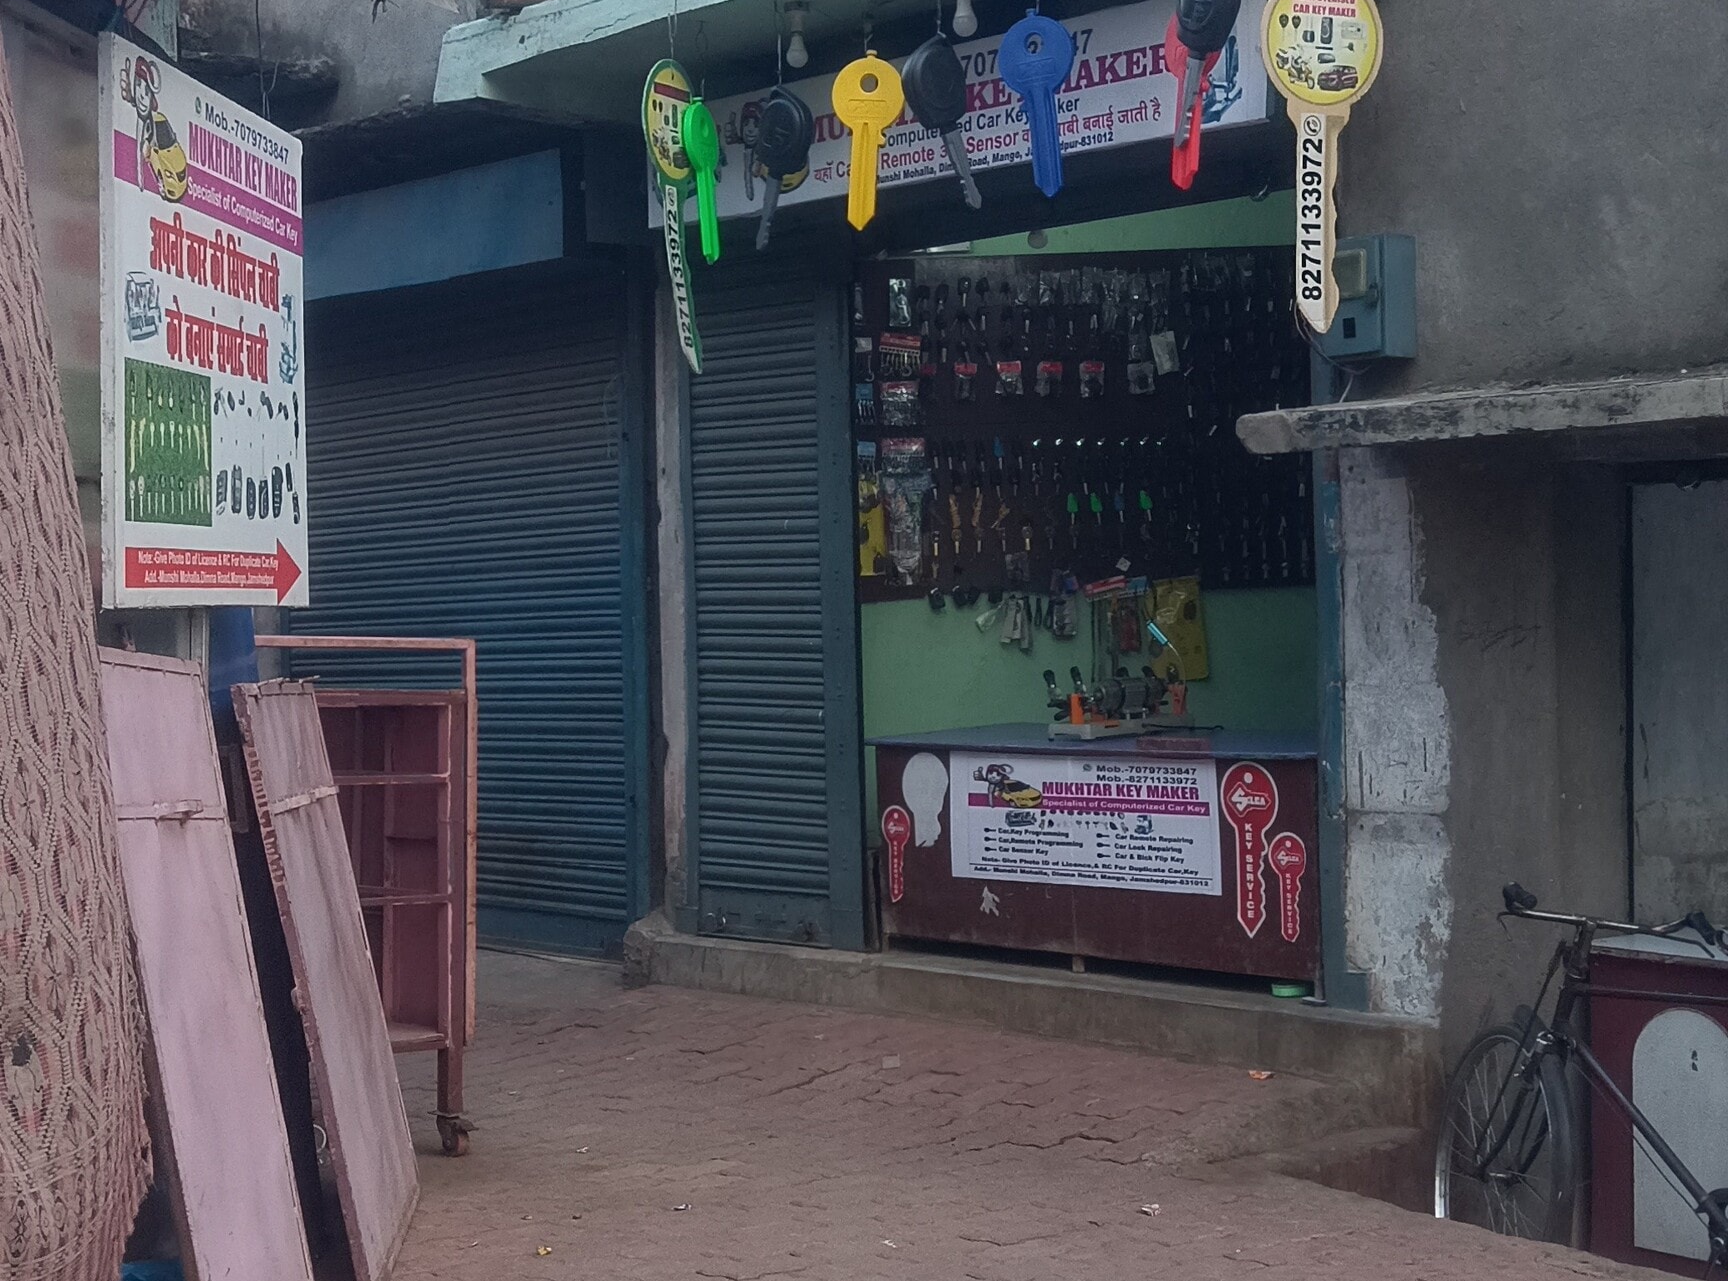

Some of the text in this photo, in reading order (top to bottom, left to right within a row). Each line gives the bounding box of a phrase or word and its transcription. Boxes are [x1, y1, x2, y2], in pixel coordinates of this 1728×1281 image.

[1293, 4, 1356, 18] CAR KEY MAKER
[977, 113, 1001, 130] Car
[205, 102, 289, 165] Mob.-7079733847
[881, 146, 935, 170] Remote
[966, 132, 1019, 154] Sensor
[1082, 105, 1114, 131] बनाई
[1117, 100, 1149, 124] जाती
[1150, 96, 1161, 122] है
[188, 120, 298, 213] MUKHTAR KEY MAKER
[187, 176, 298, 246] Specialist of Computerized Car Key
[1301, 138, 1323, 301] 8271133972
[150, 211, 184, 279] अपनी
[185, 231, 208, 287] कार
[209, 229, 226, 293] की
[258, 252, 280, 313] चाबी
[165, 295, 183, 362] को
[246, 323, 269, 384] चाबी
[168, 551, 184, 565] Photo
[185, 552, 191, 565] ID
[1096, 765, 1197, 775] Mob.-7079733847
[1096, 774, 1198, 785] Mob.-8271133972
[1042, 782, 1199, 800] MUKHTAR KEY MAKER
[1042, 799, 1087, 808] Specialist
[1100, 801, 1165, 811] Computerized
[1167, 803, 1186, 811] Car
[1188, 805, 1206, 813] Key
[1035, 848, 1049, 856] Key
[1170, 856, 1184, 864] Key
[1244, 823, 1255, 918] KEY SERVICE
